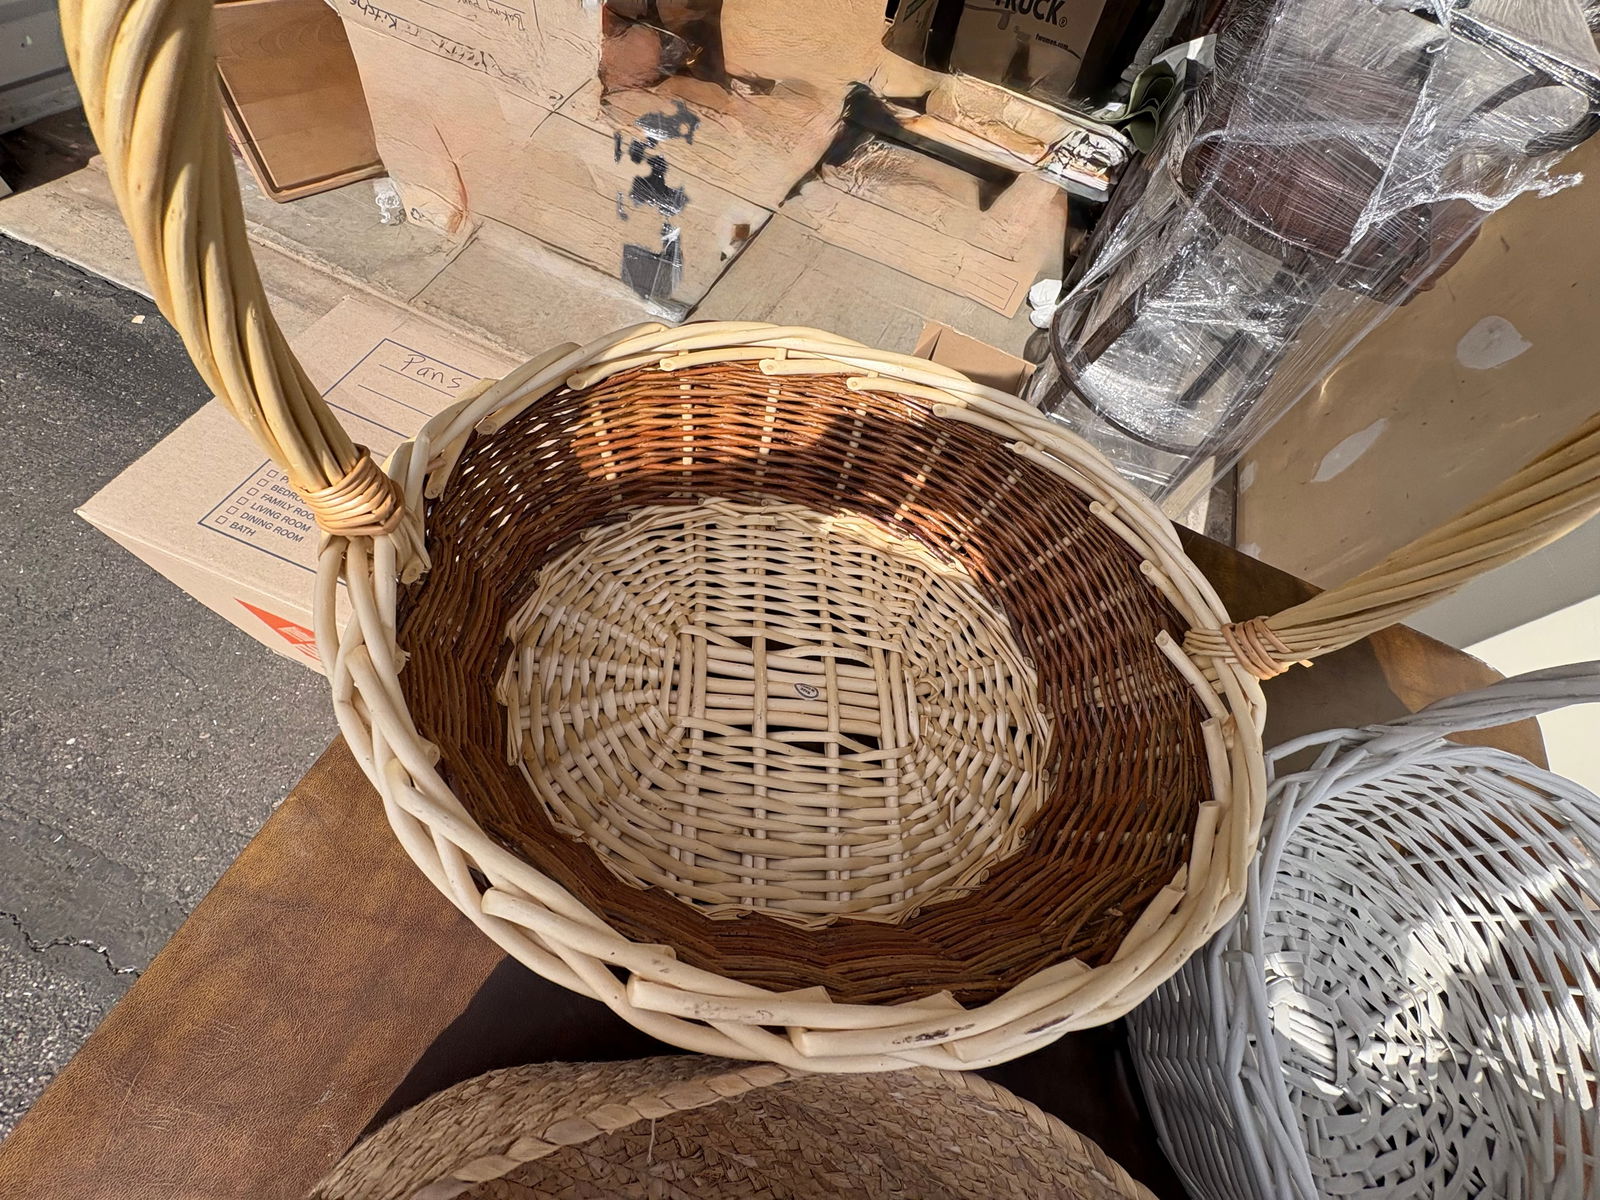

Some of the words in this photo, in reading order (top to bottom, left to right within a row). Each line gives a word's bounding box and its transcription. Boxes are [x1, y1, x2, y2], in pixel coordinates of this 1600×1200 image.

[400, 353, 463, 389] Pans
[250, 502, 282, 520] LIVING
[280, 515, 312, 532] ROOM
[260, 493, 295, 511] FAMILY
[293, 507, 316, 521] ROO
[229, 521, 257, 537] BATH
[240, 512, 274, 530] DINING
[272, 526, 305, 543] ROOM
